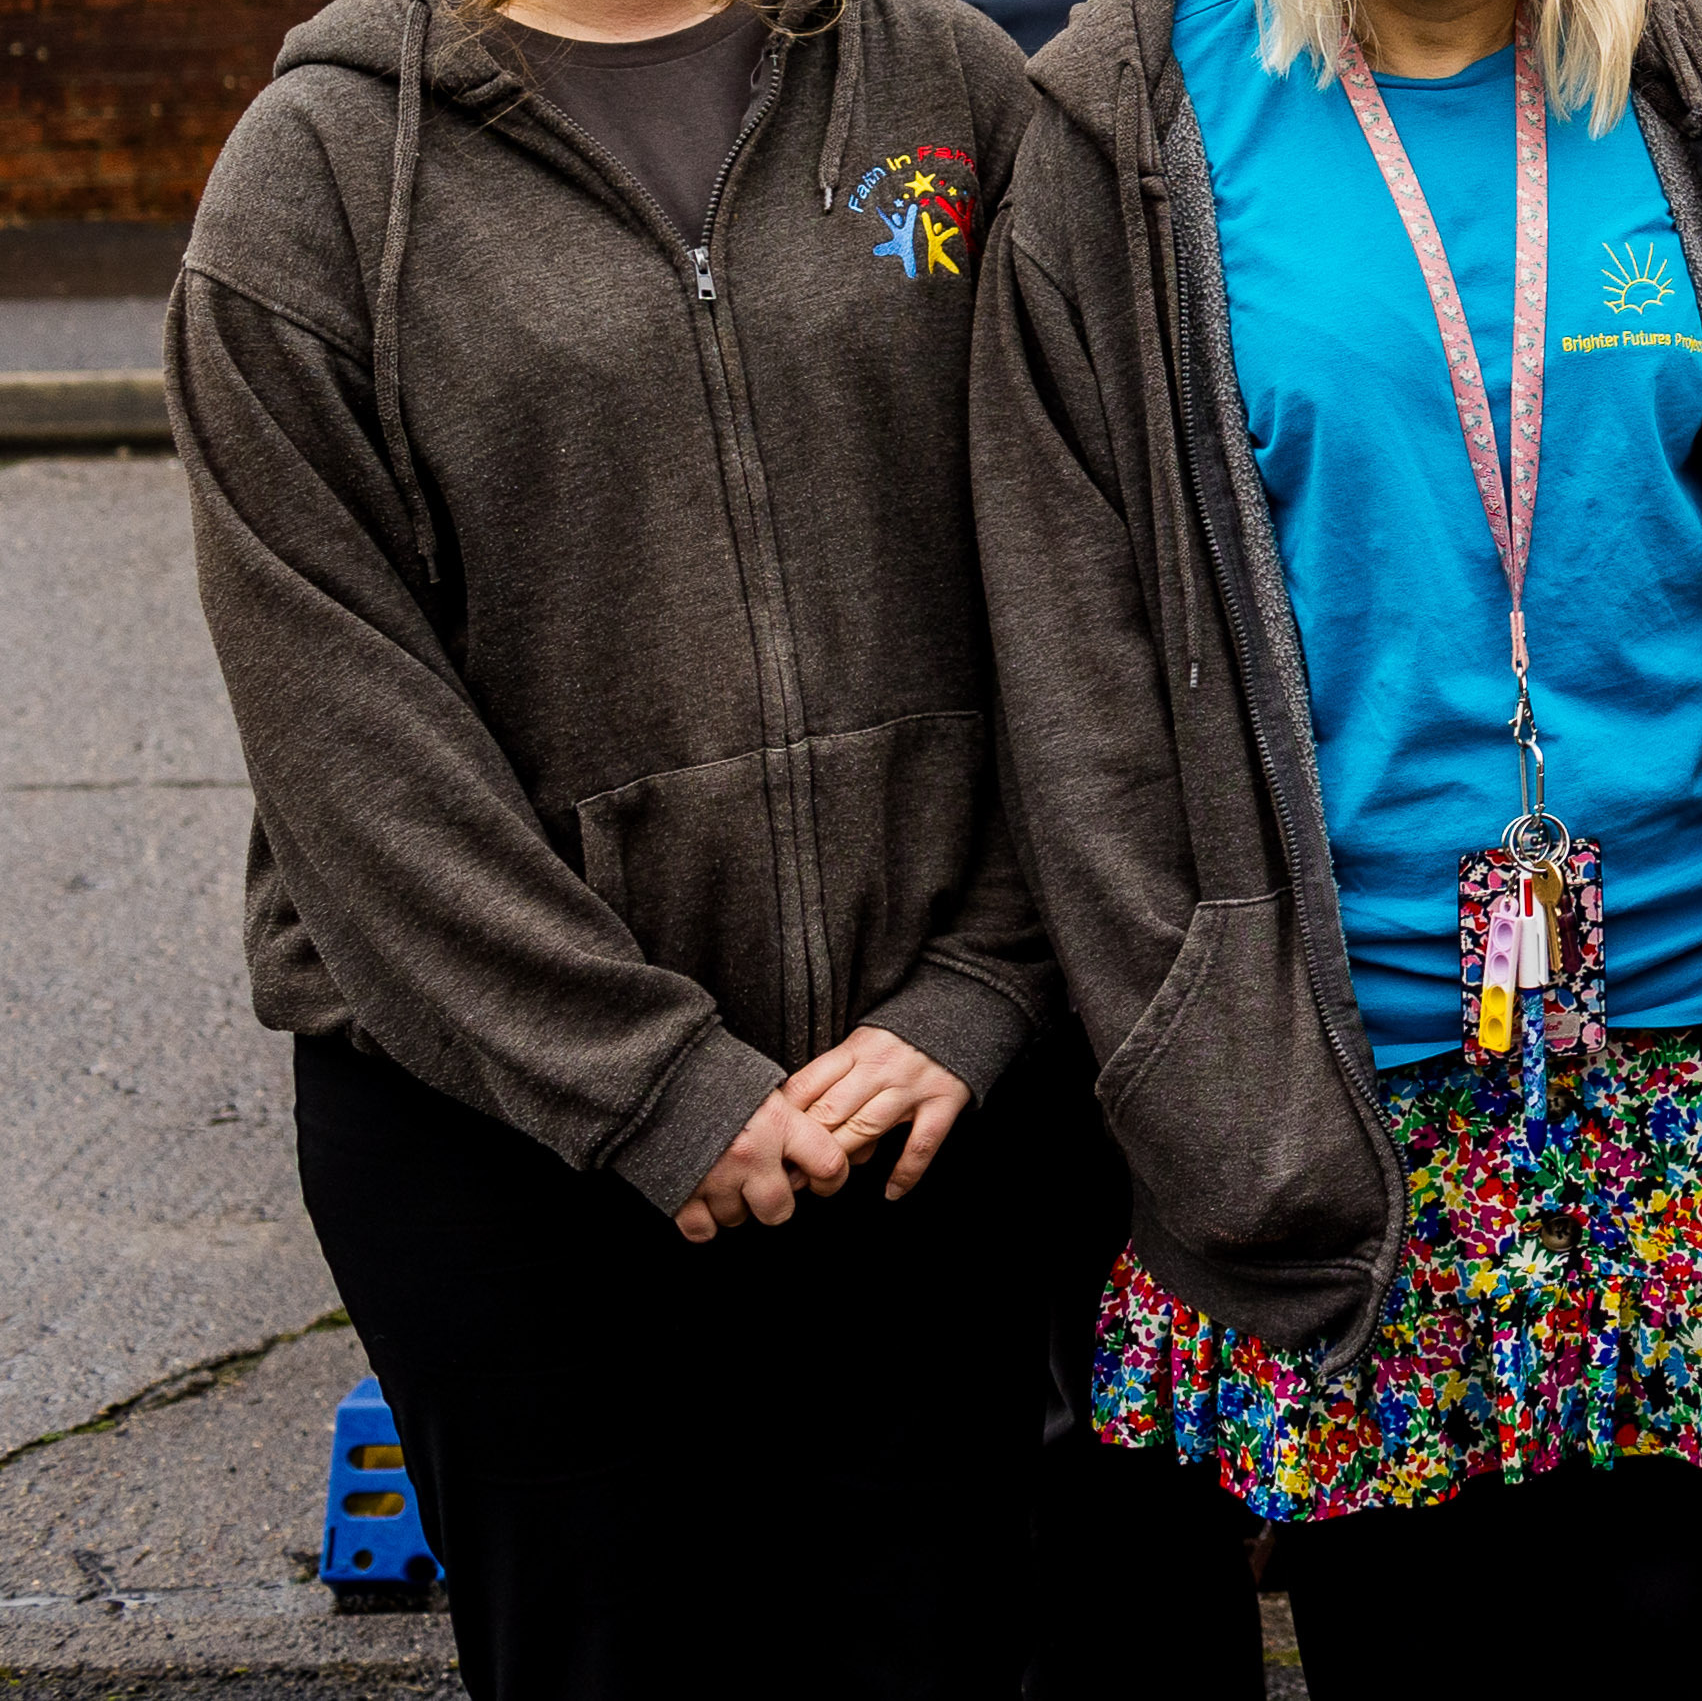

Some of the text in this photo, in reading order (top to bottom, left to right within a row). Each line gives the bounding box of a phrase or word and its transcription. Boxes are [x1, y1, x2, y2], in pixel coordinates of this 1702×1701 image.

[848, 166, 888, 214] Faith
[886, 154, 912, 172] In
[1562, 333, 1619, 353] Brighter
[1622, 330, 1672, 346] Futures
